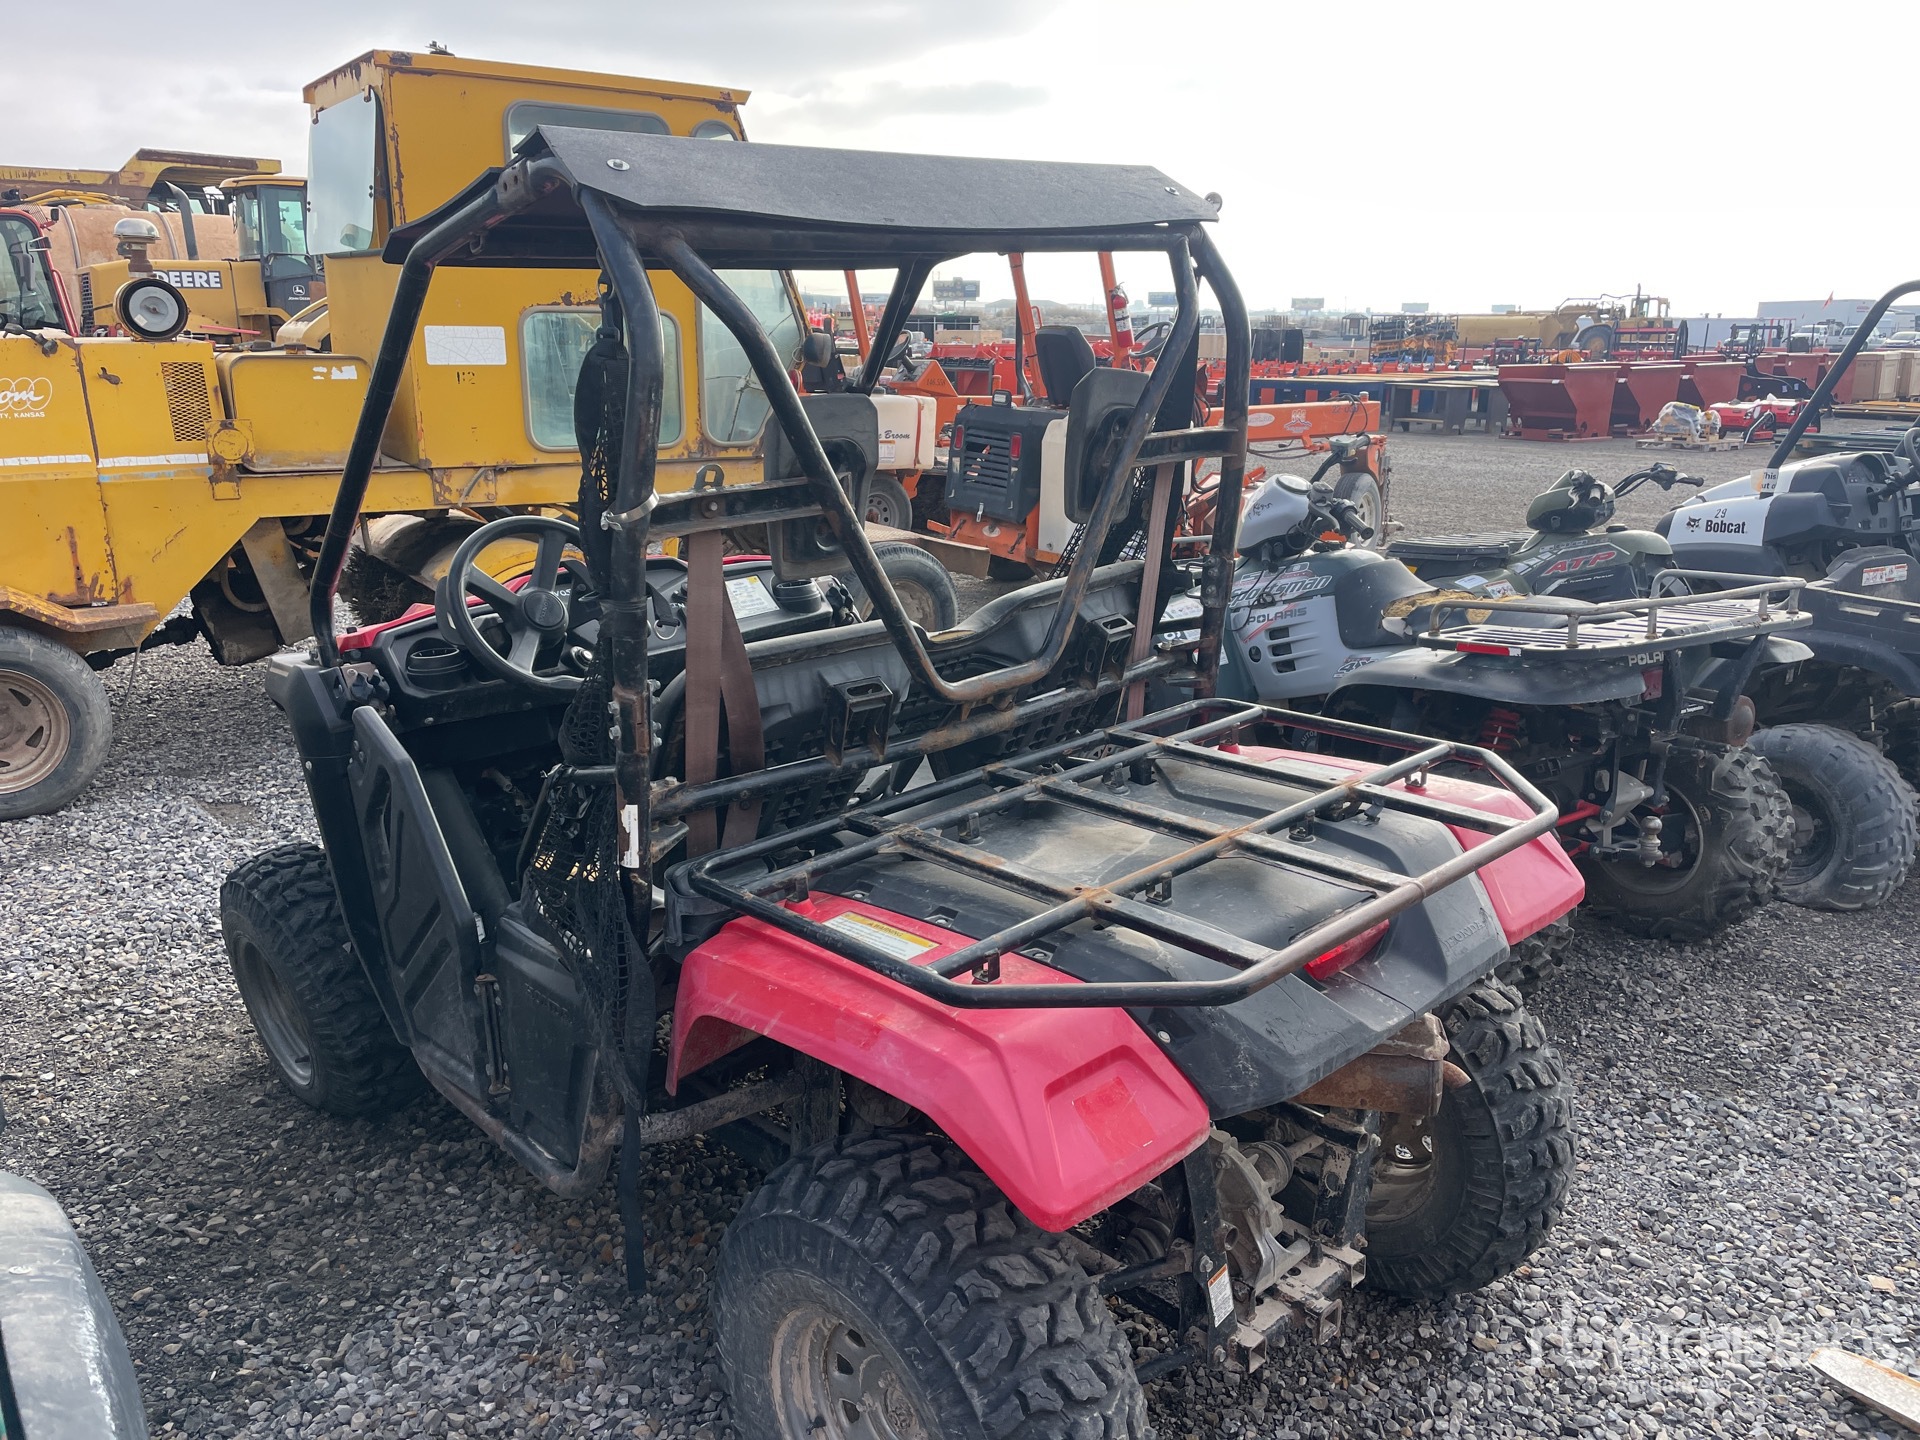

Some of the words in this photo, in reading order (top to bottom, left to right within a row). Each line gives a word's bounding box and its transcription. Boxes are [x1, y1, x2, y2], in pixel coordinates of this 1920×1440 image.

[153, 271, 222, 288] DEERE
[884, 429, 911, 439] Broom
[1714, 508, 1728, 519] 29
[1705, 519, 1746, 534] Bobcat
[1541, 551, 1617, 577] ATP
[1247, 606, 1307, 626] POLARIS
